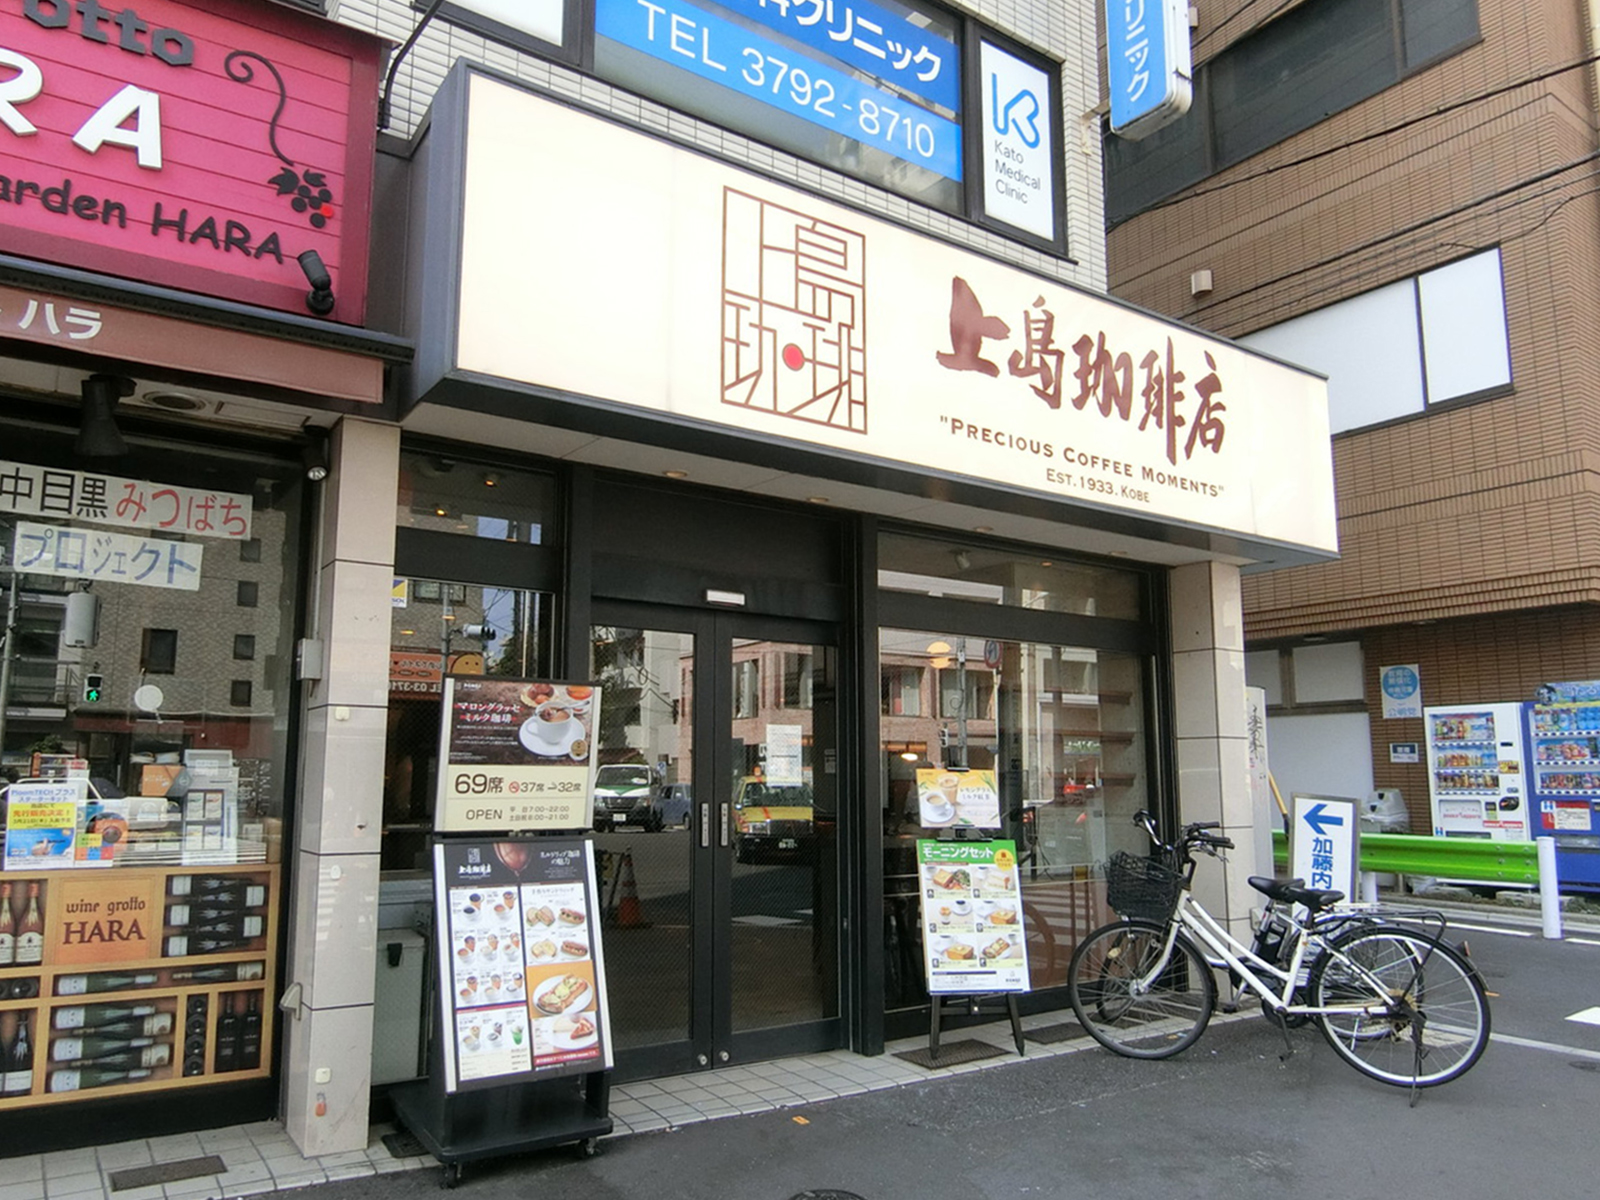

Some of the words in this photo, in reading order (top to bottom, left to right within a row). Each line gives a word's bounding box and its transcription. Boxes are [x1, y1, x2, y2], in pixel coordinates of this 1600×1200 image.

[1124, 0, 1149, 102] リニック
[637, 1, 727, 72] TEL
[741, 46, 935, 158] 3792-8710
[995, 139, 1024, 165] Kato
[995, 158, 1041, 191] Medical
[995, 178, 1028, 205] Clinic
[151, 202, 284, 265] HARA
[18, 299, 103, 340] ハラ
[936, 275, 1228, 466] 上島珈琲店
[1063, 447, 1133, 477] COFFEE
[0, 467, 248, 536] 中目黒みつばち
[20, 528, 197, 584] プロジェクト
[465, 809, 503, 820] OPEN
[923, 847, 994, 859] モーニングセット
[66, 898, 101, 914] wine
[107, 896, 146, 916] grotto
[62, 919, 146, 945] HARA
